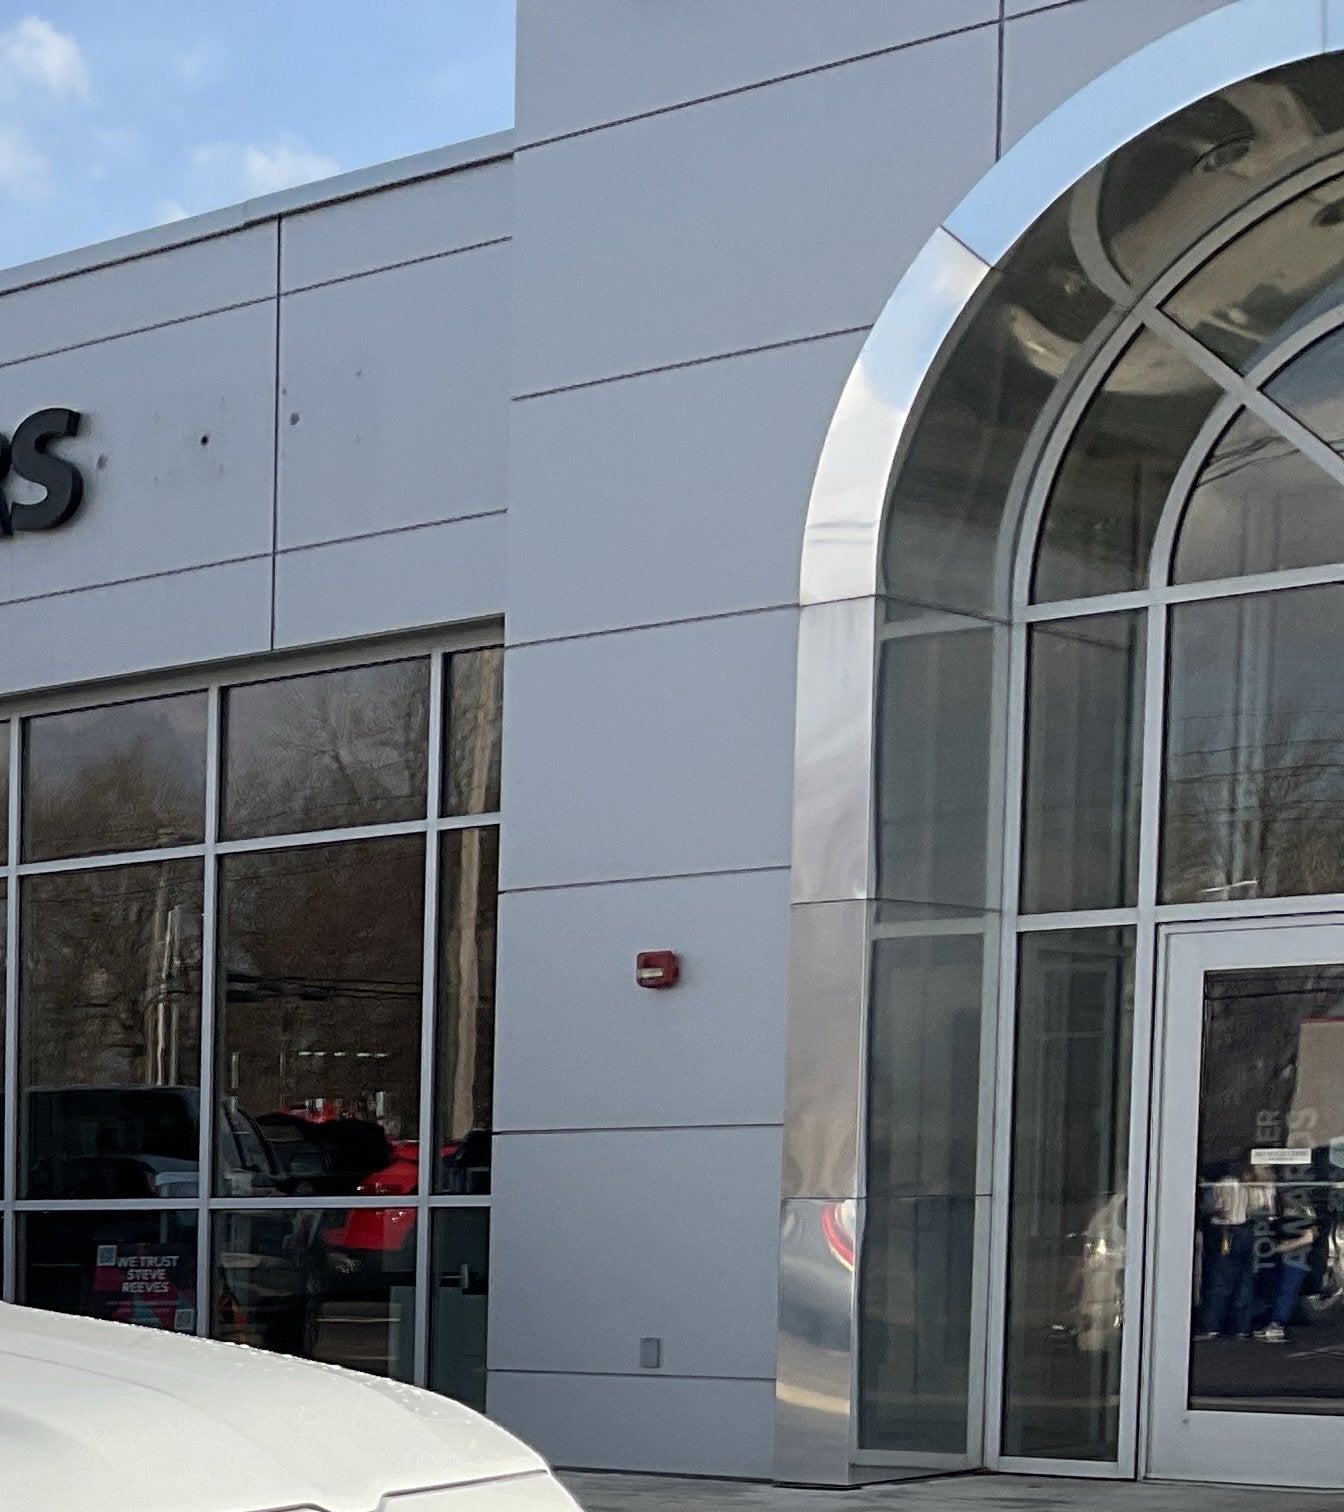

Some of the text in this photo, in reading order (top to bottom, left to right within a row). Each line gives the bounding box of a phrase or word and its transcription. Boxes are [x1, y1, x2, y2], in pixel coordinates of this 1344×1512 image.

[116, 1255, 180, 1267] WE TRUST
[126, 1268, 166, 1280] STEVE
[121, 1281, 170, 1293] REEVES
